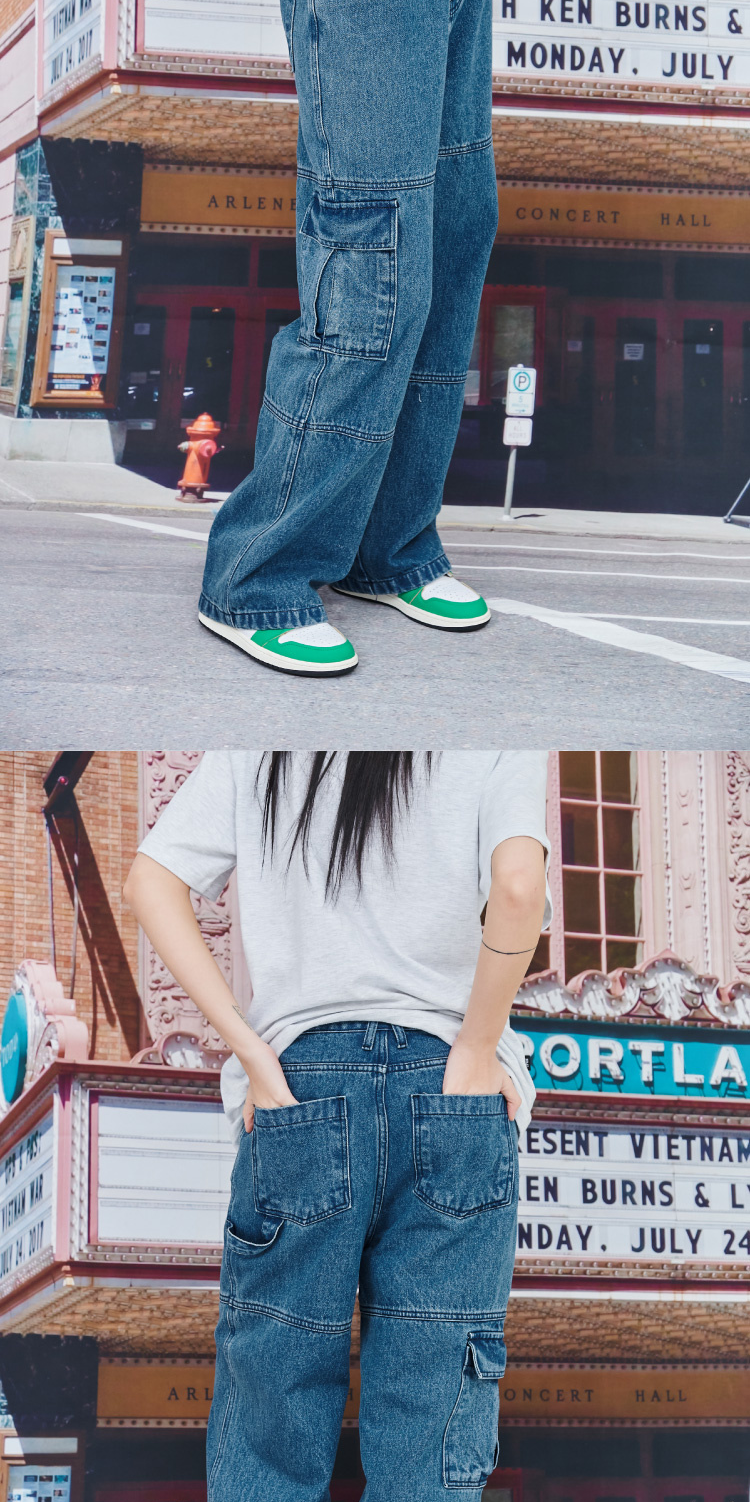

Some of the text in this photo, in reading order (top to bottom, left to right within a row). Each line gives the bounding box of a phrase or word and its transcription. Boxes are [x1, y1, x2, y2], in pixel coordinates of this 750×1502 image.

[615, 1, 707, 32] BURNS
[727, 9, 743, 34] &
[662, 52, 734, 81] JULY
[207, 195, 297, 210] ARLENE
[515, 207, 712, 227] CONCERT HALL
[518, 1128, 750, 1163] ESENT VIETNAM
[519, 1175, 559, 1203] EN
[582, 1179, 673, 1207] BURNS
[694, 1182, 710, 1208] &
[631, 1227, 702, 1255] JULY
[635, 1389, 687, 1402] HALL
